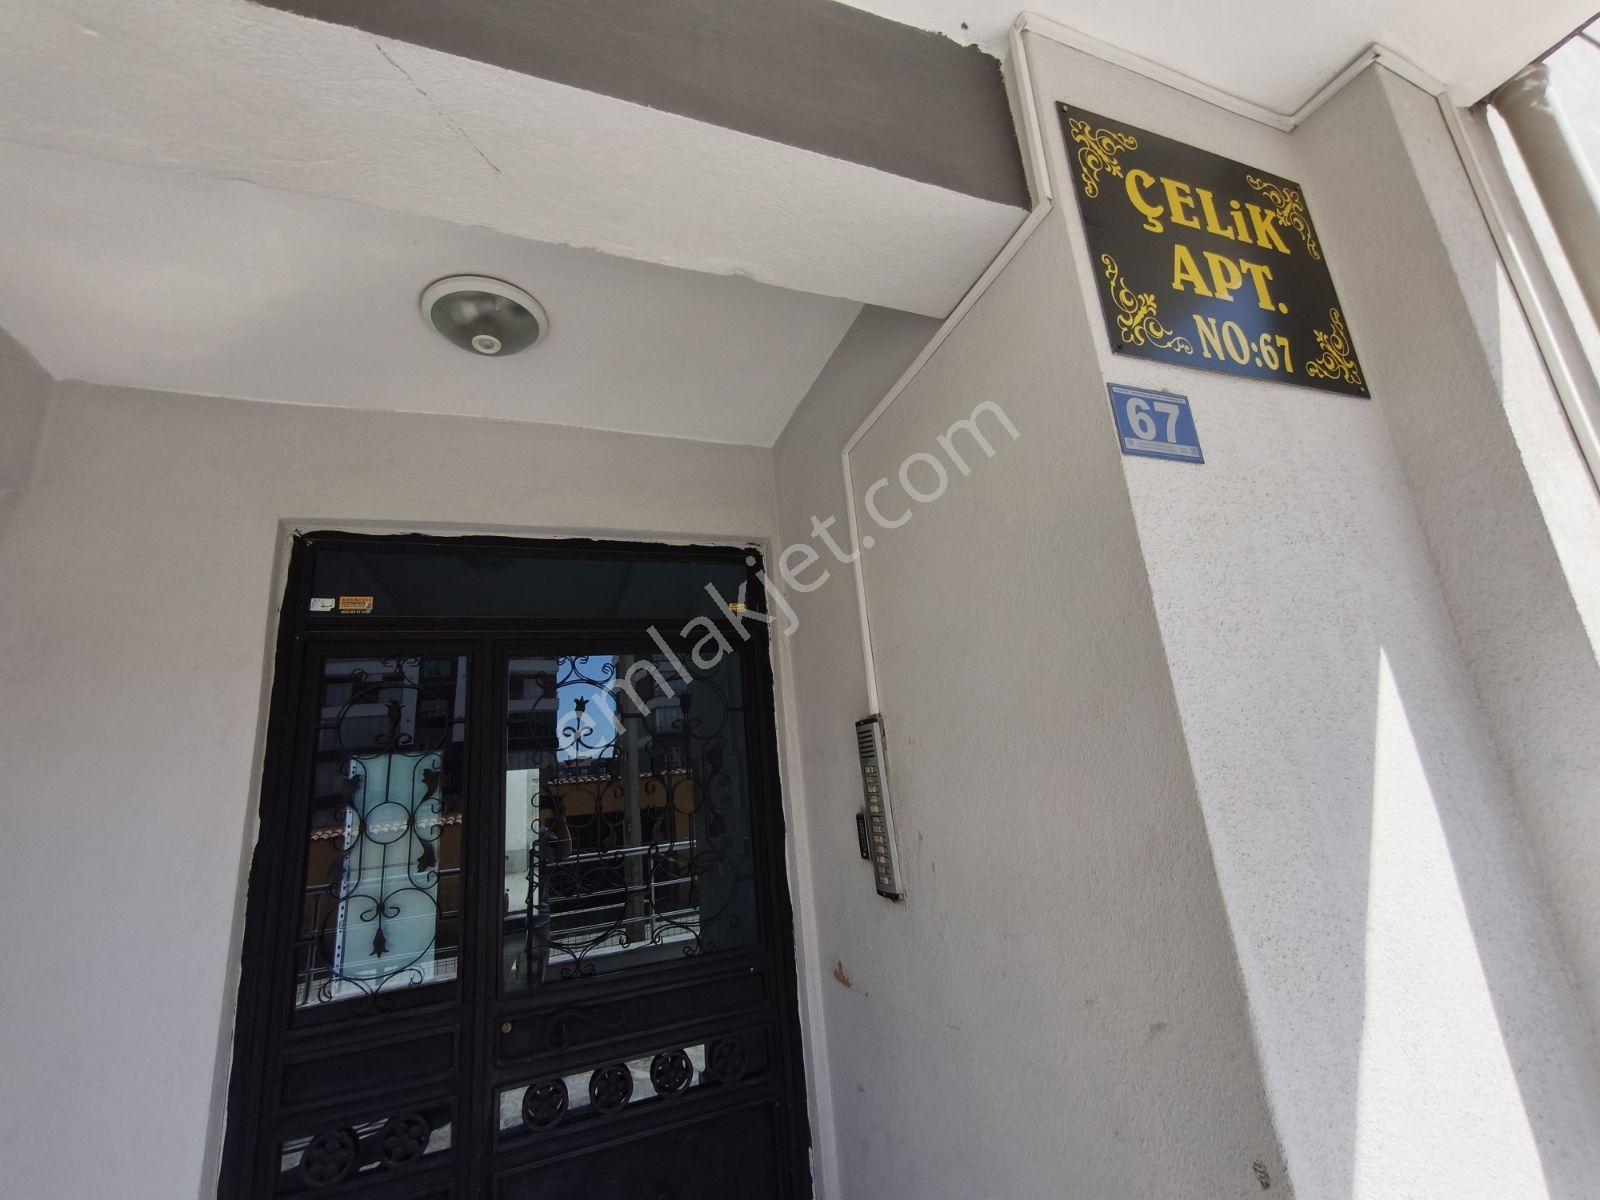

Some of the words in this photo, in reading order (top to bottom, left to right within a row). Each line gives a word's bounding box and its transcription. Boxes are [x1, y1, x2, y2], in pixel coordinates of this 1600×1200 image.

[1172, 243, 1288, 315] APT.
[1192, 313, 1294, 374] NO:67
[1126, 397, 1180, 444] 67
